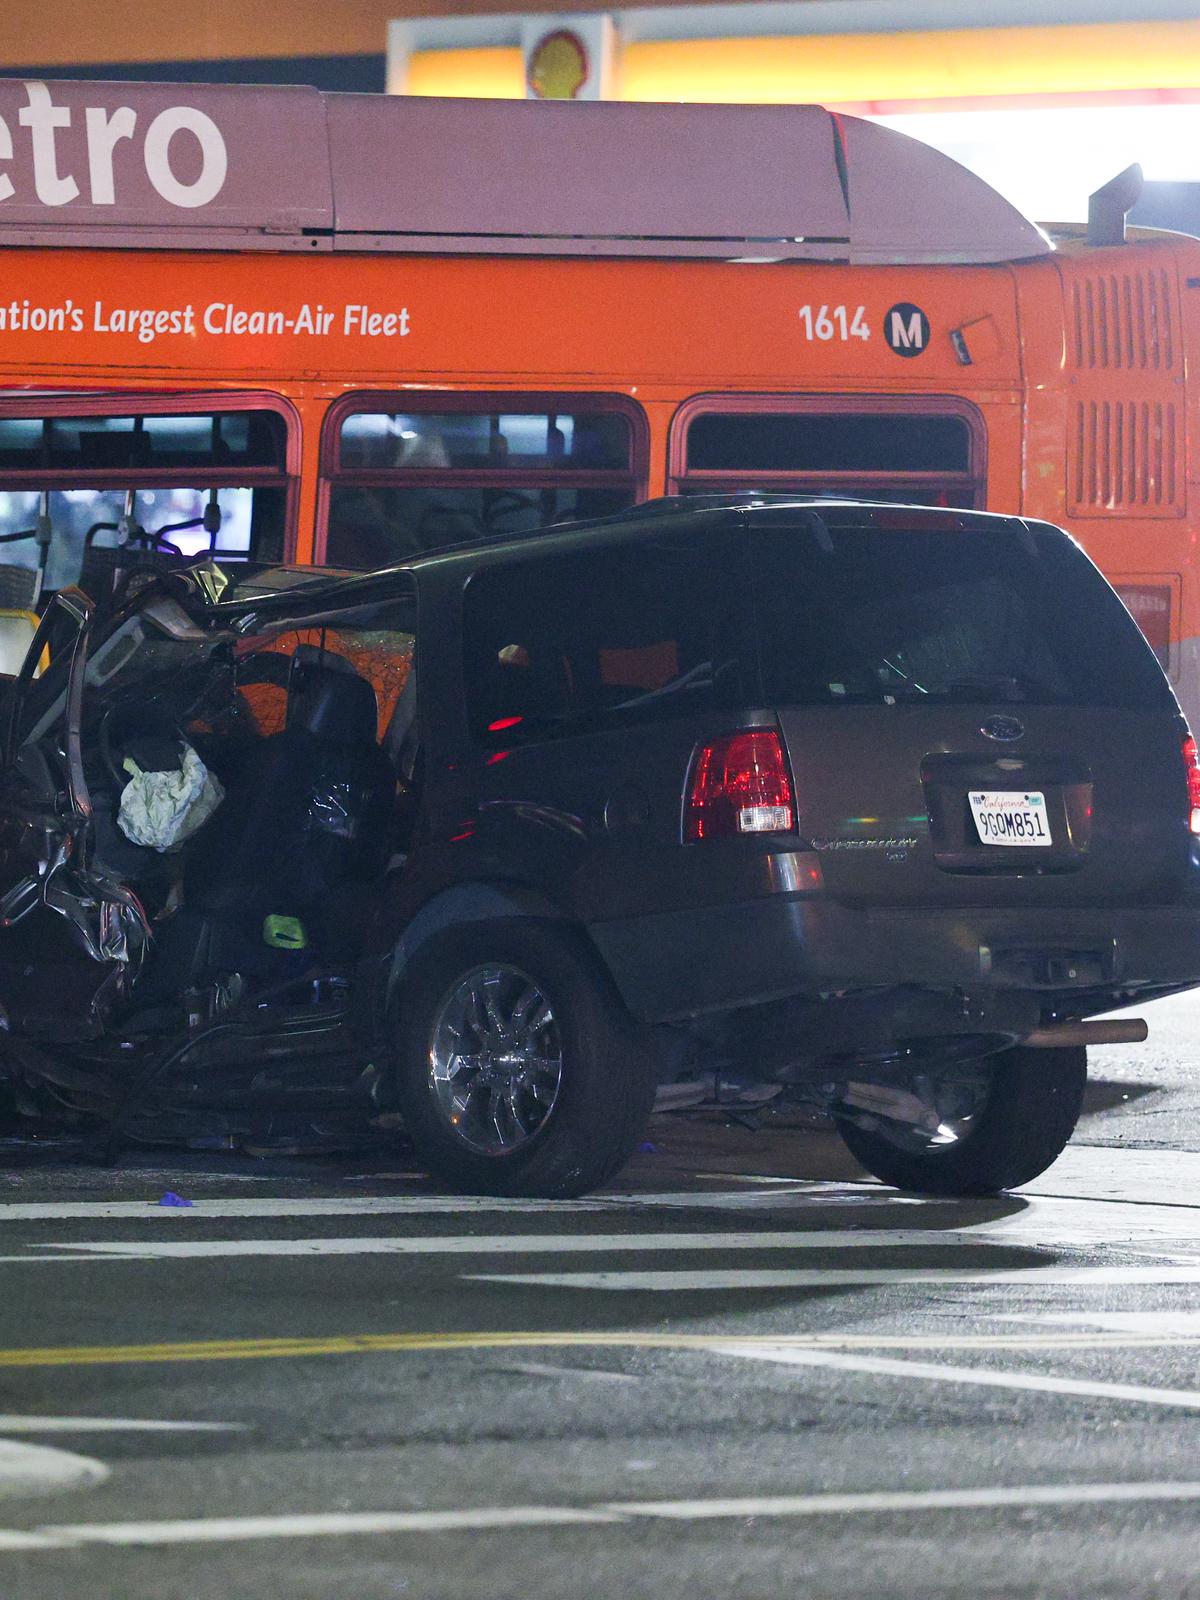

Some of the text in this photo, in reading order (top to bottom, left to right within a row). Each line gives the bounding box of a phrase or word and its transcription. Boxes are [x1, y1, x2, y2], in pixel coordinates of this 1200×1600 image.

[94, 301, 195, 343] Largest
[203, 303, 335, 335] Clean-Air
[344, 305, 411, 336] Fleet
[799, 305, 871, 341] 1614
[891, 312, 923, 348] M
[984, 796, 1029, 810] California
